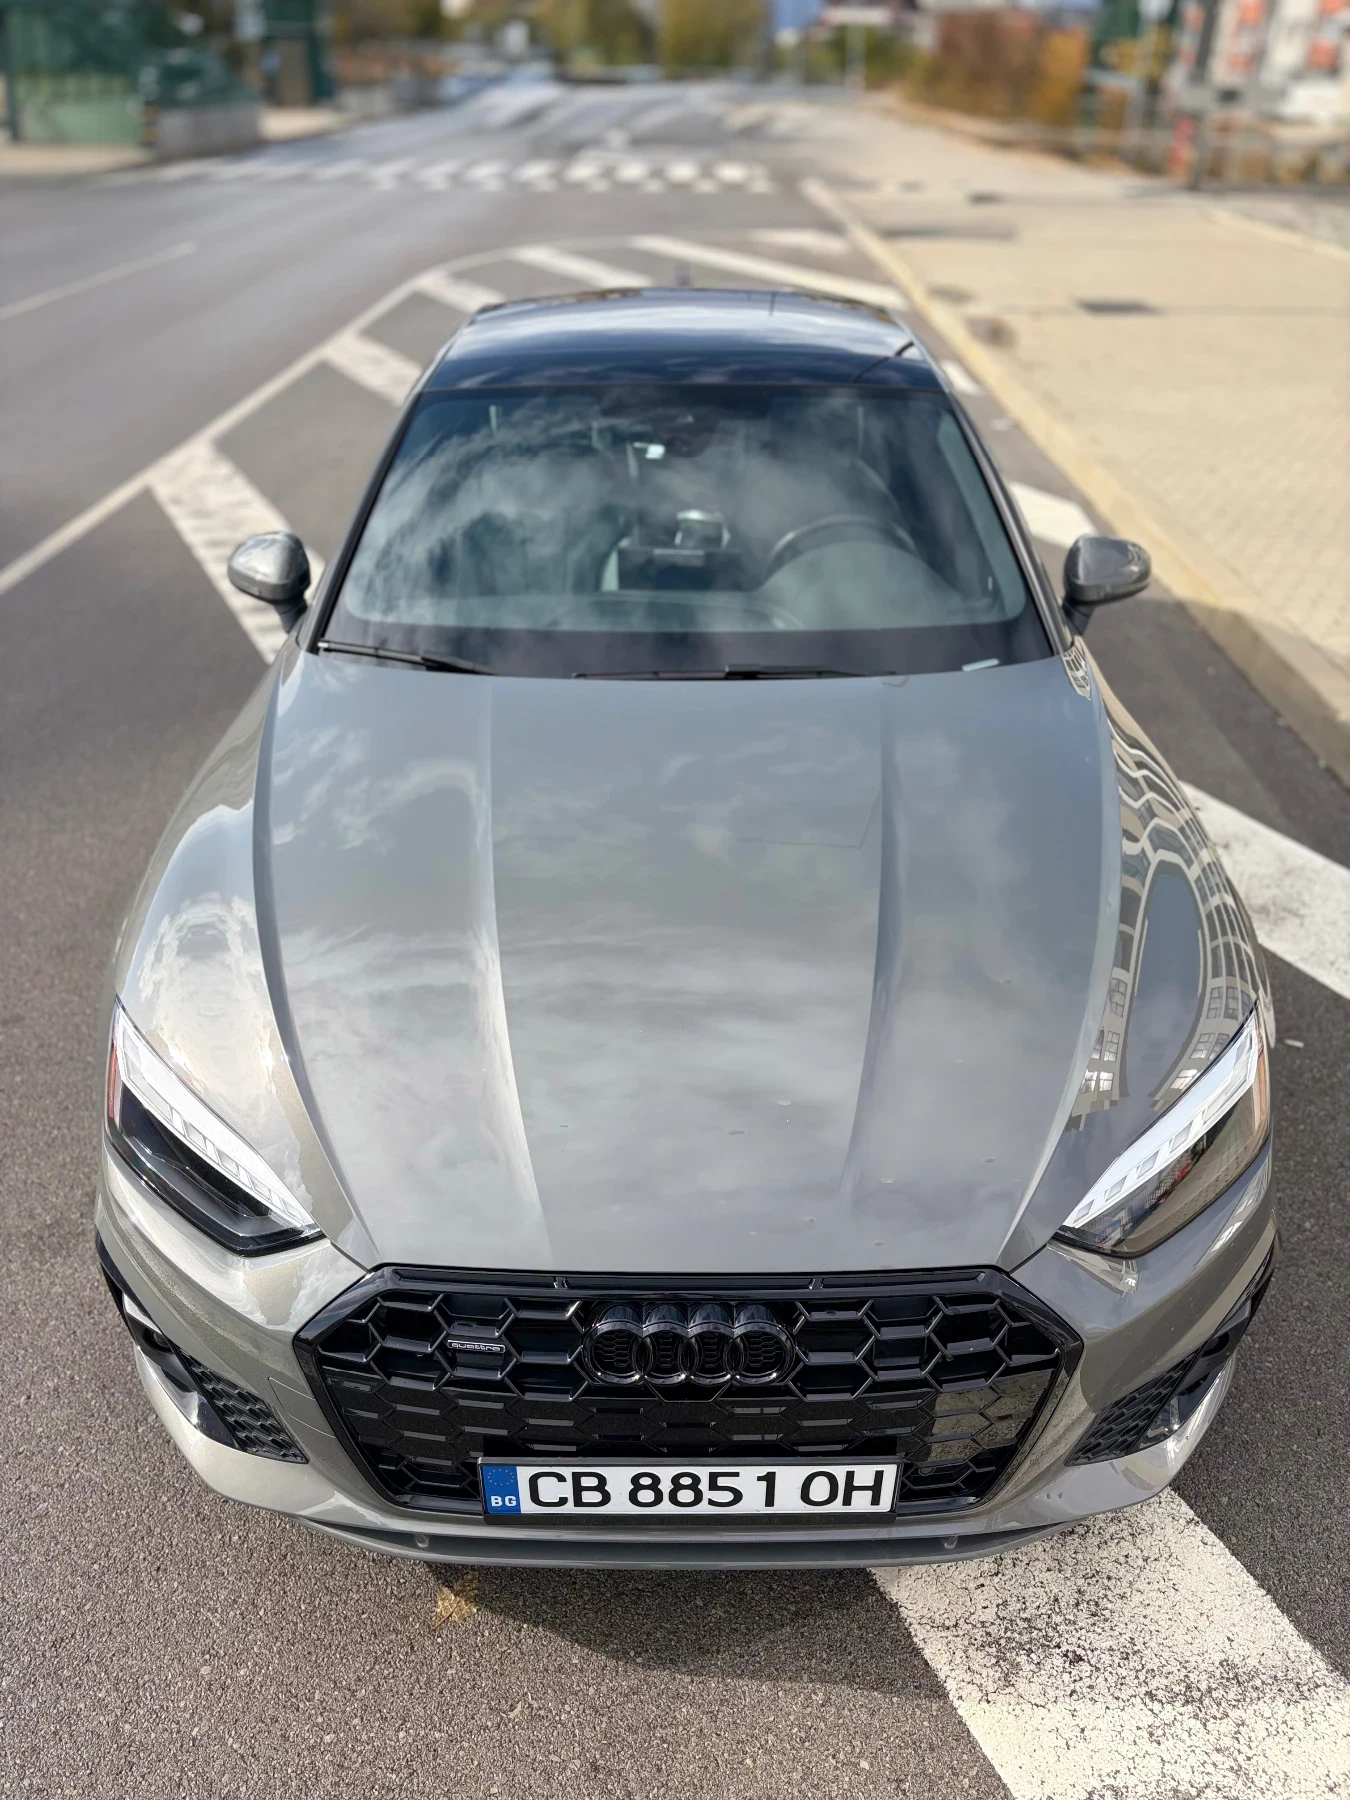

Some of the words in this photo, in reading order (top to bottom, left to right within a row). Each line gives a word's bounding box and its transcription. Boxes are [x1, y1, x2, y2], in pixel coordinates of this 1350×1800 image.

[451, 1342, 501, 1352] quattro
[528, 1471, 612, 1508] CB
[628, 1471, 777, 1508] 8851
[800, 1469, 885, 1507] OH
[490, 1495, 517, 1507] BG
